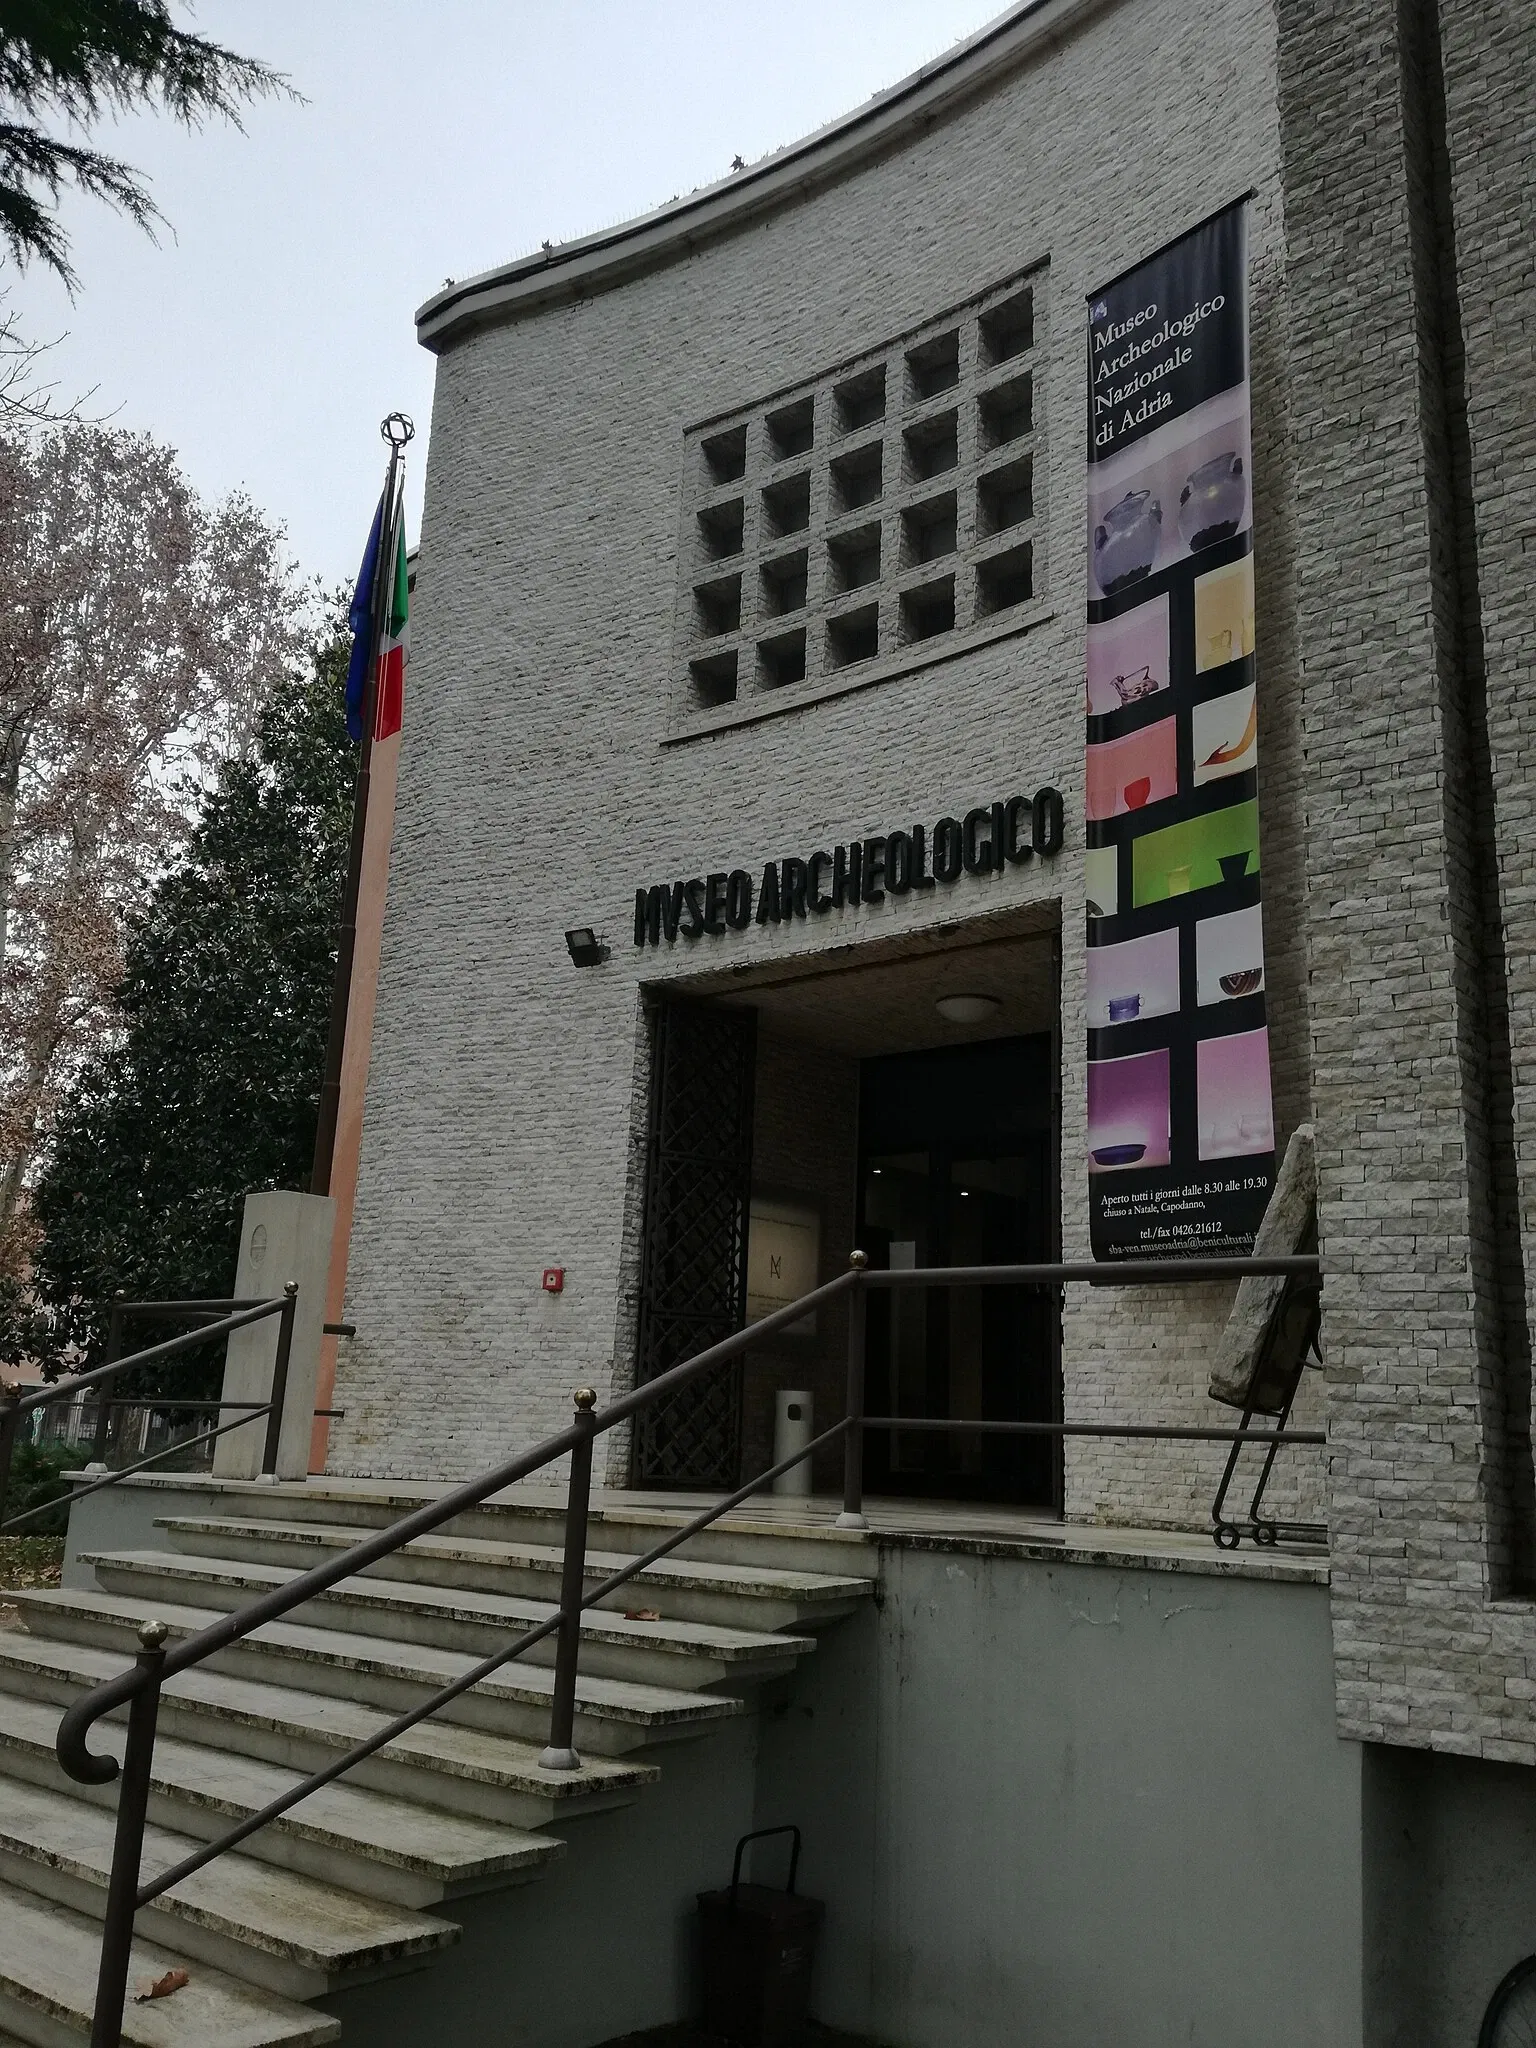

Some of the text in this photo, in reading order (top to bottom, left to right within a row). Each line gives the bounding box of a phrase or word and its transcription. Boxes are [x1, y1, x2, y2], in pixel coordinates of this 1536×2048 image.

[1094, 304, 1158, 353] Museo
[1094, 295, 1226, 384] Archeologico
[1094, 346, 1193, 415] Nazionale
[1095, 391, 1173, 447] di Adria
[633, 786, 1064, 948] MVSEO ARCHEOLOGICO
[1100, 1195, 1130, 1207] Aperto
[1131, 1190, 1149, 1202] tutti
[1155, 1186, 1180, 1202] giorni
[1182, 1184, 1202, 1197] dalle
[1204, 1181, 1223, 1193] 8.30
[1224, 1180, 1241, 1192] alle
[1243, 1176, 1268, 1189] 19.30
[1103, 1207, 1127, 1218] chiuso
[1134, 1204, 1160, 1215] Natale,
[1161, 1200, 1206, 1214] Capodanno,
[1108, 1232, 1259, 1255] sba-ven.museoadria@beniculturali.i
[1140, 1221, 1222, 1239] tel./fax 0426.21612
